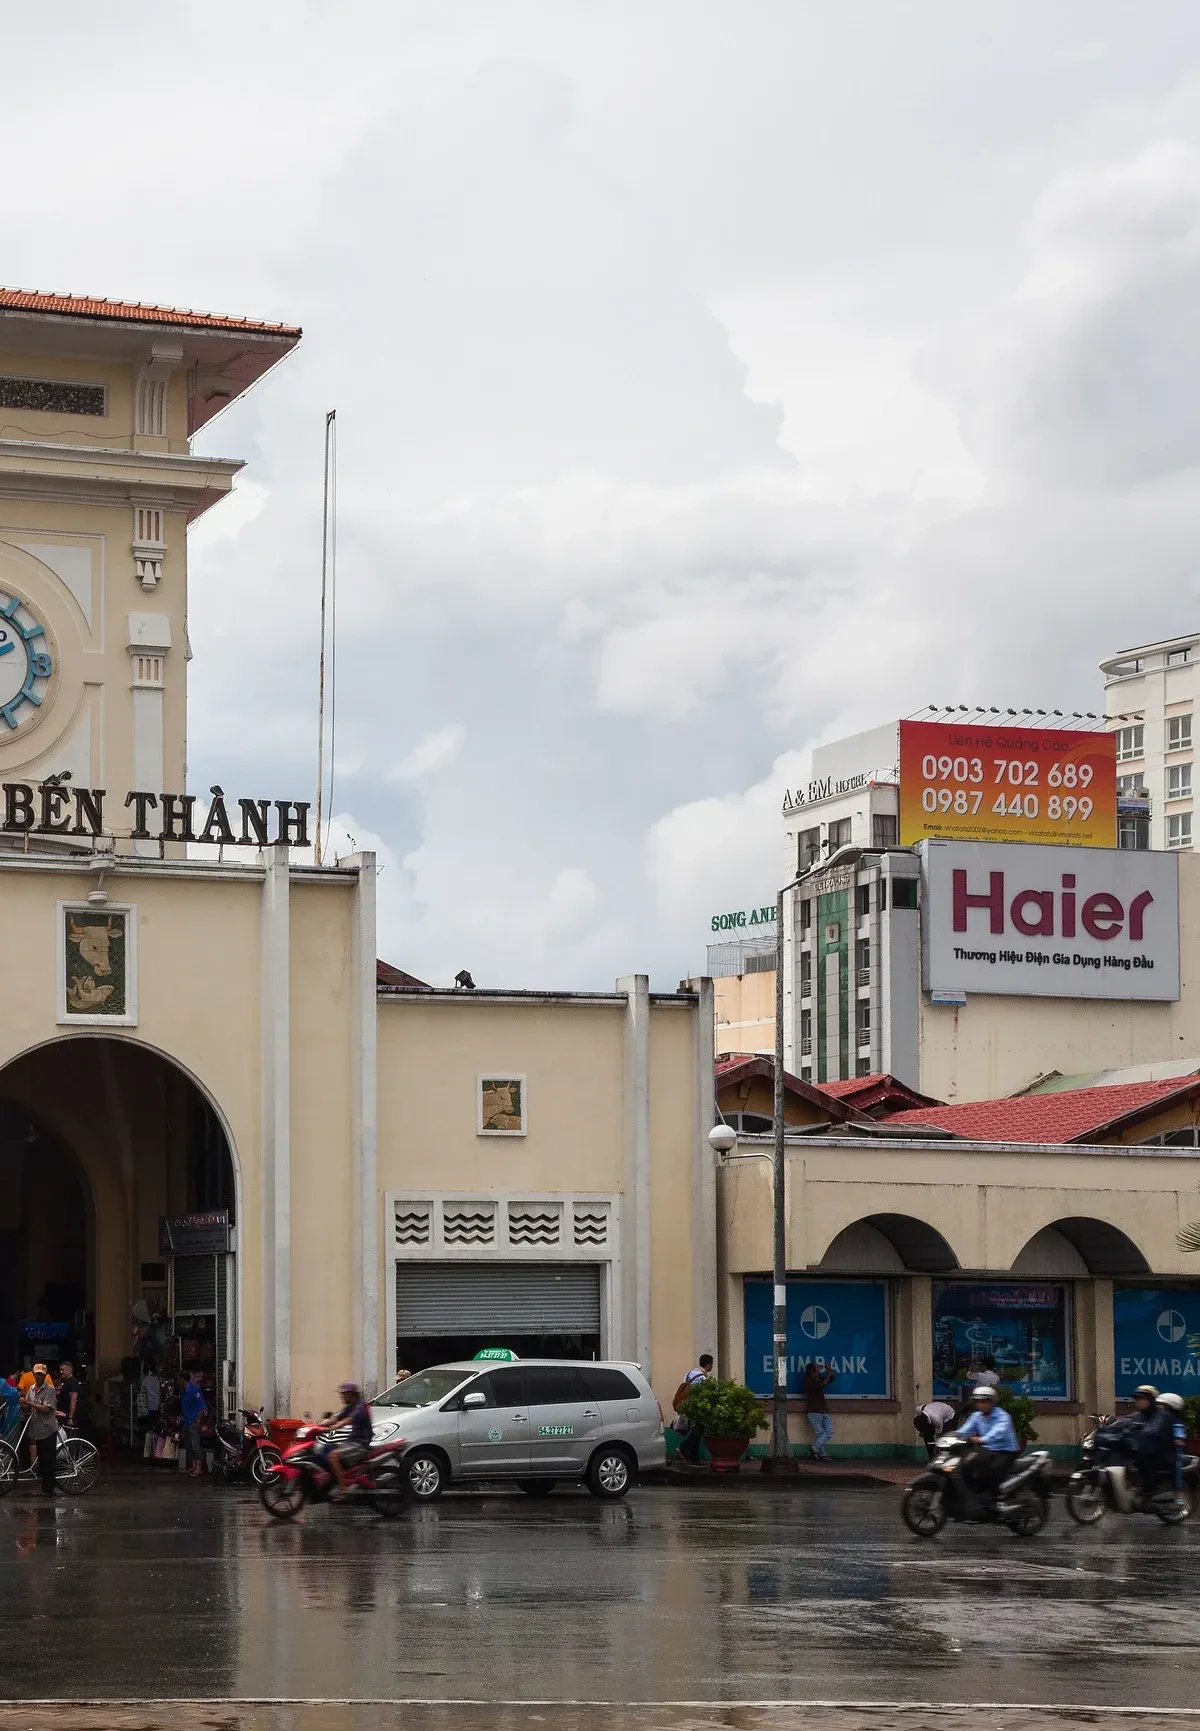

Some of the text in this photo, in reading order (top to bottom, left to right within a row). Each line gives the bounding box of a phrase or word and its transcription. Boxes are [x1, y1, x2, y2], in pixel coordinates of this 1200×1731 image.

[31, 653, 52, 677] 3
[922, 754, 1094, 789] 0903 702 689
[1, 770, 107, 834] BẾN
[124, 784, 312, 847] THÀNH
[782, 789, 794, 811] A
[922, 787, 984, 815] 0987
[991, 792, 1040, 819] 440
[1047, 795, 1094, 821] 899
[952, 868, 1155, 941] Haier
[711, 911, 747, 932] SONG
[953, 947, 1154, 970] Thương Hiệu Điện Gia Dụng Hàng Đầu
[762, 1354, 869, 1374] EIMBANK
[1120, 1357, 1200, 1376] EXIMBA
